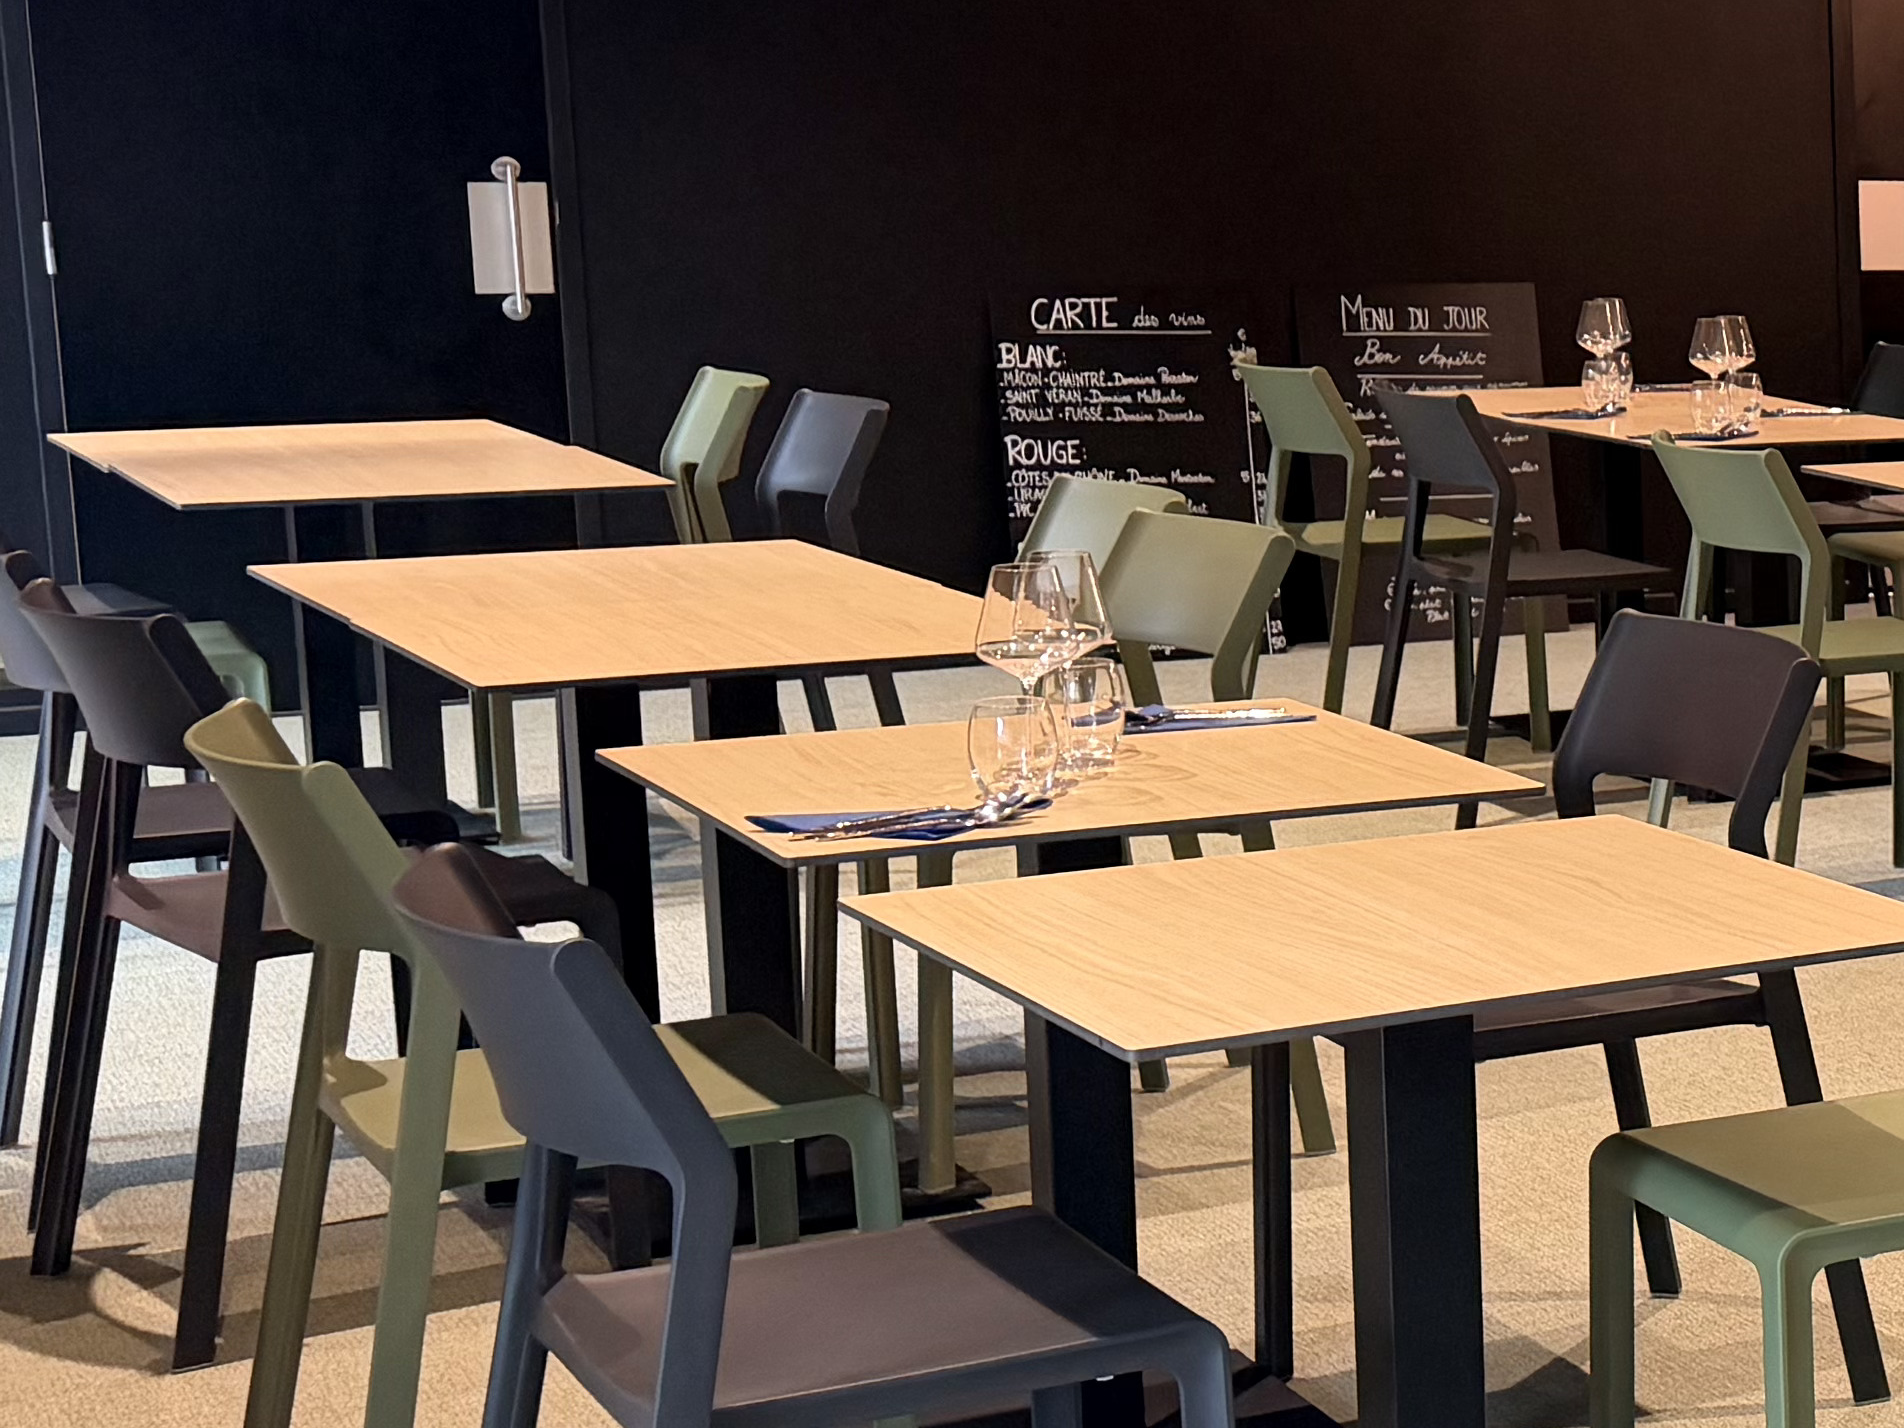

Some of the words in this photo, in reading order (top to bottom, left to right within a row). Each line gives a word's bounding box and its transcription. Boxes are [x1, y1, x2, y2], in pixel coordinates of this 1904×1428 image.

[1030, 296, 1118, 330] CARTE
[1132, 305, 1160, 328] des
[1168, 312, 1206, 327] vins
[1340, 294, 1395, 332] MENU
[1407, 306, 1430, 331] DU
[1443, 305, 1490, 331] JOUR
[1354, 338, 1401, 367] Bon
[1004, 434, 1088, 466] ROUGE:
[1011, 467, 1051, 487] CÔTES
